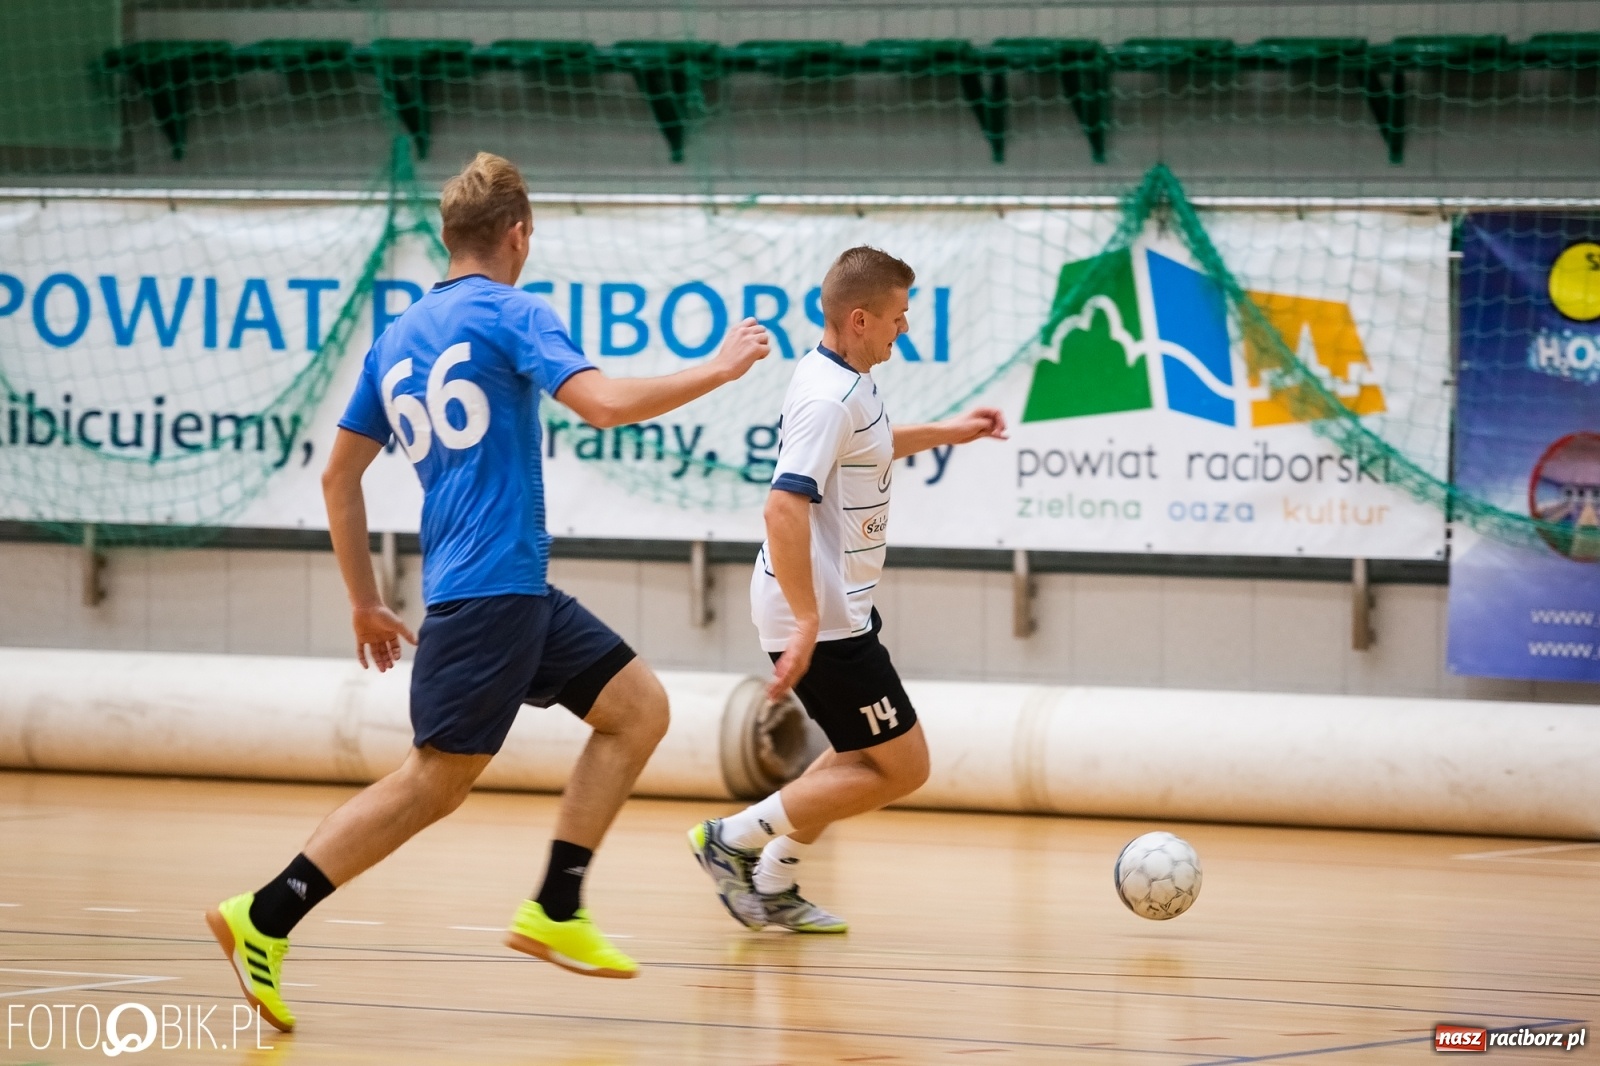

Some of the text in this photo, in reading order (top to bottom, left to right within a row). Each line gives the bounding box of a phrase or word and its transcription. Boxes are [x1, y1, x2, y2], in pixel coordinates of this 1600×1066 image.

[381, 341, 491, 464] 66
[0, 391, 314, 469] ibicujemy,
[1017, 437, 1391, 488] powiat raciborski
[1017, 493, 1390, 525] zielona oaza kultur
[859, 695, 899, 736] 14
